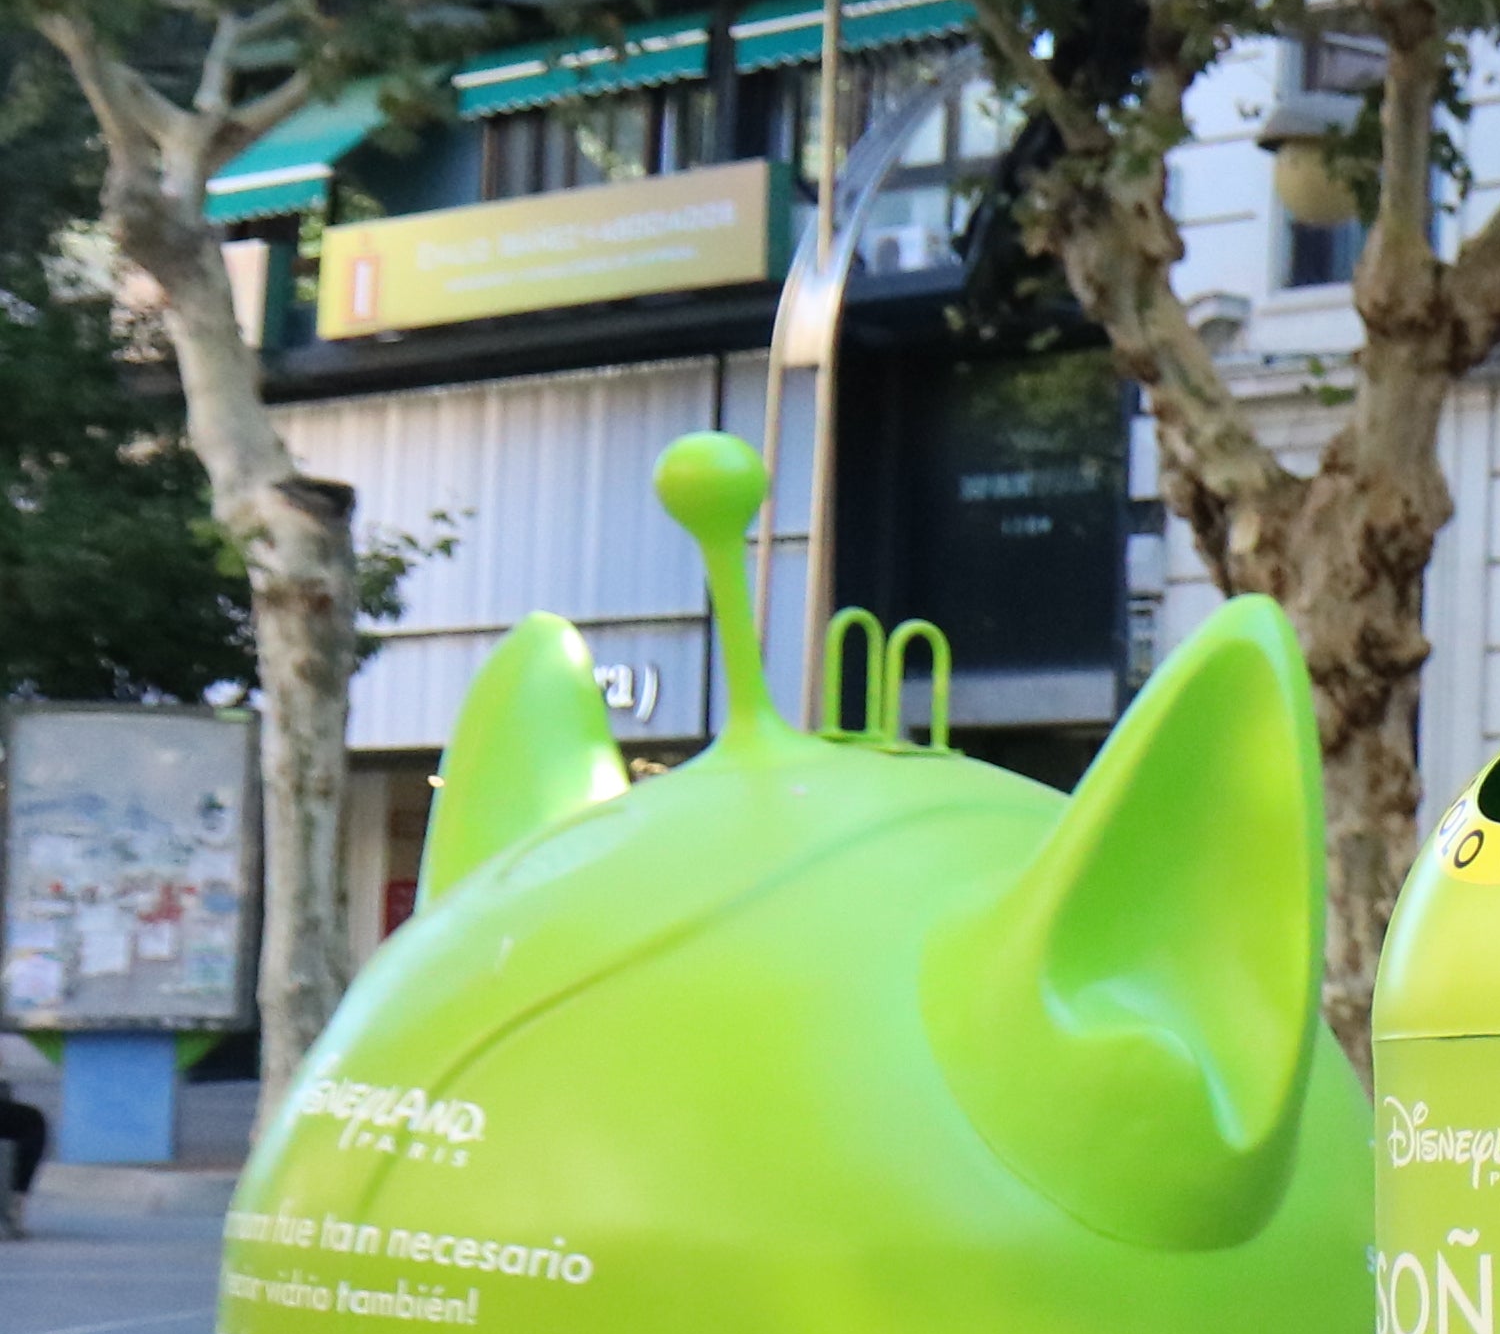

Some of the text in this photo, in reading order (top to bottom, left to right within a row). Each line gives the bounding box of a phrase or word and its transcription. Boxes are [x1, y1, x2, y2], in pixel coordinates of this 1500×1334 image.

[1438, 797, 1484, 869] OLO
[354, 1130, 470, 1168] PARIS
[320, 1213, 381, 1256] tan
[387, 1227, 595, 1285] necesario
[336, 1279, 481, 1326] también!
